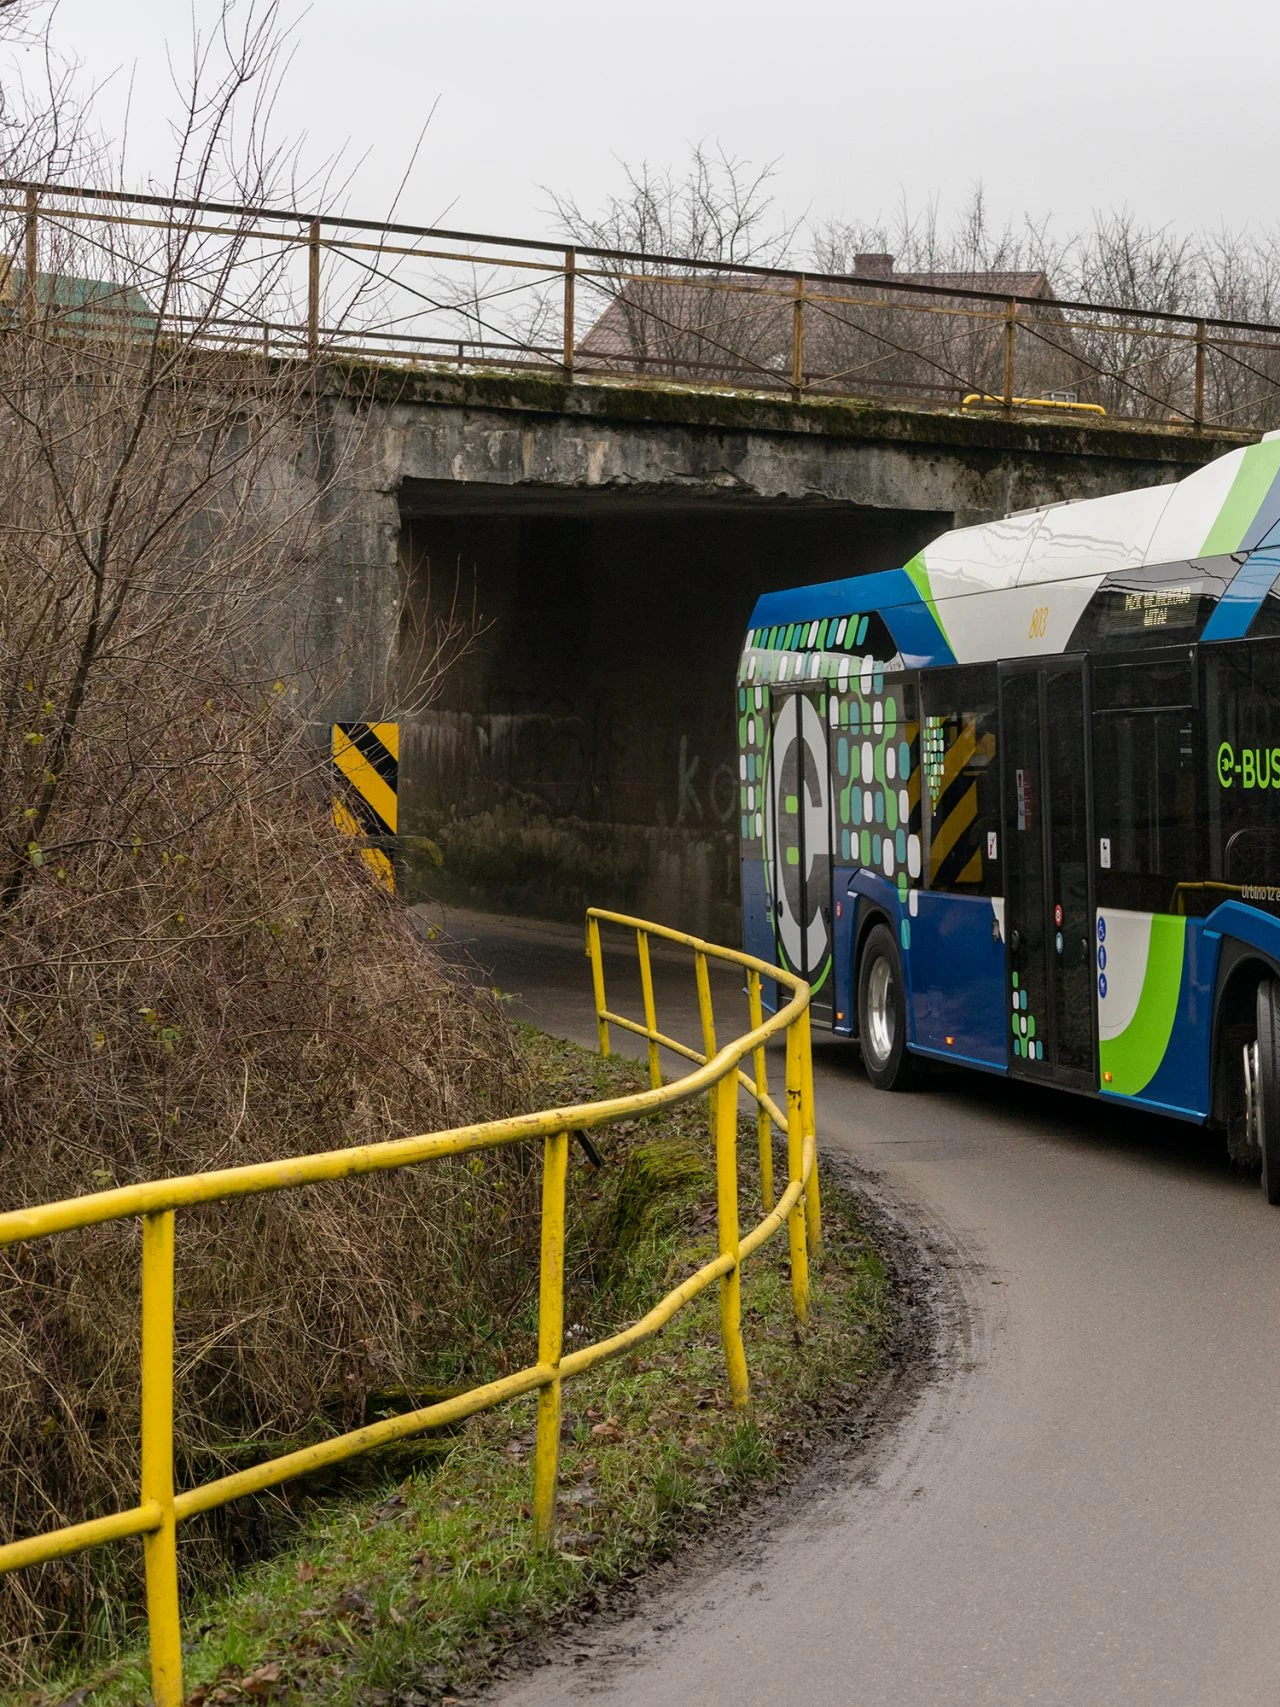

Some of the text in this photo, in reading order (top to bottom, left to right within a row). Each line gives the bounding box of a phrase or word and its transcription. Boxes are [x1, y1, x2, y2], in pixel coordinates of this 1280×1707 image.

[1028, 607, 1049, 639] 803
[1241, 884, 1267, 900] Urbino
[1267, 885, 1275, 901] 12
